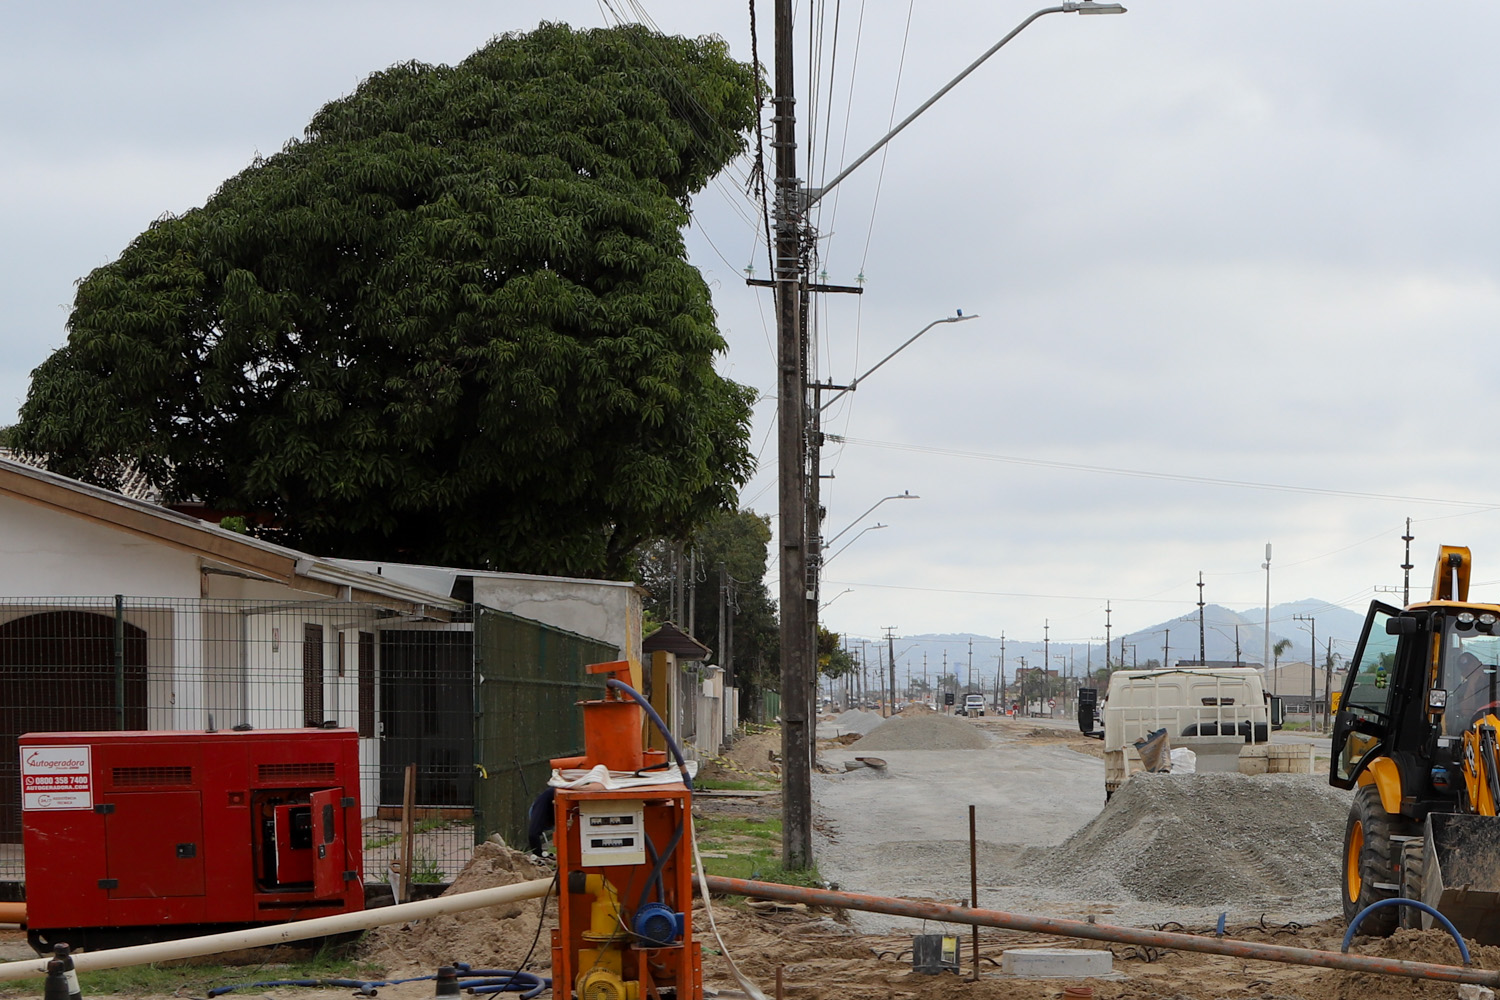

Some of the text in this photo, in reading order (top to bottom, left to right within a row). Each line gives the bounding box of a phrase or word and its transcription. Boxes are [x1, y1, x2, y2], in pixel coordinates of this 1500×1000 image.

[30, 759, 85, 769] Autogeradora
[35, 776, 88, 785] 0800 358 7400
